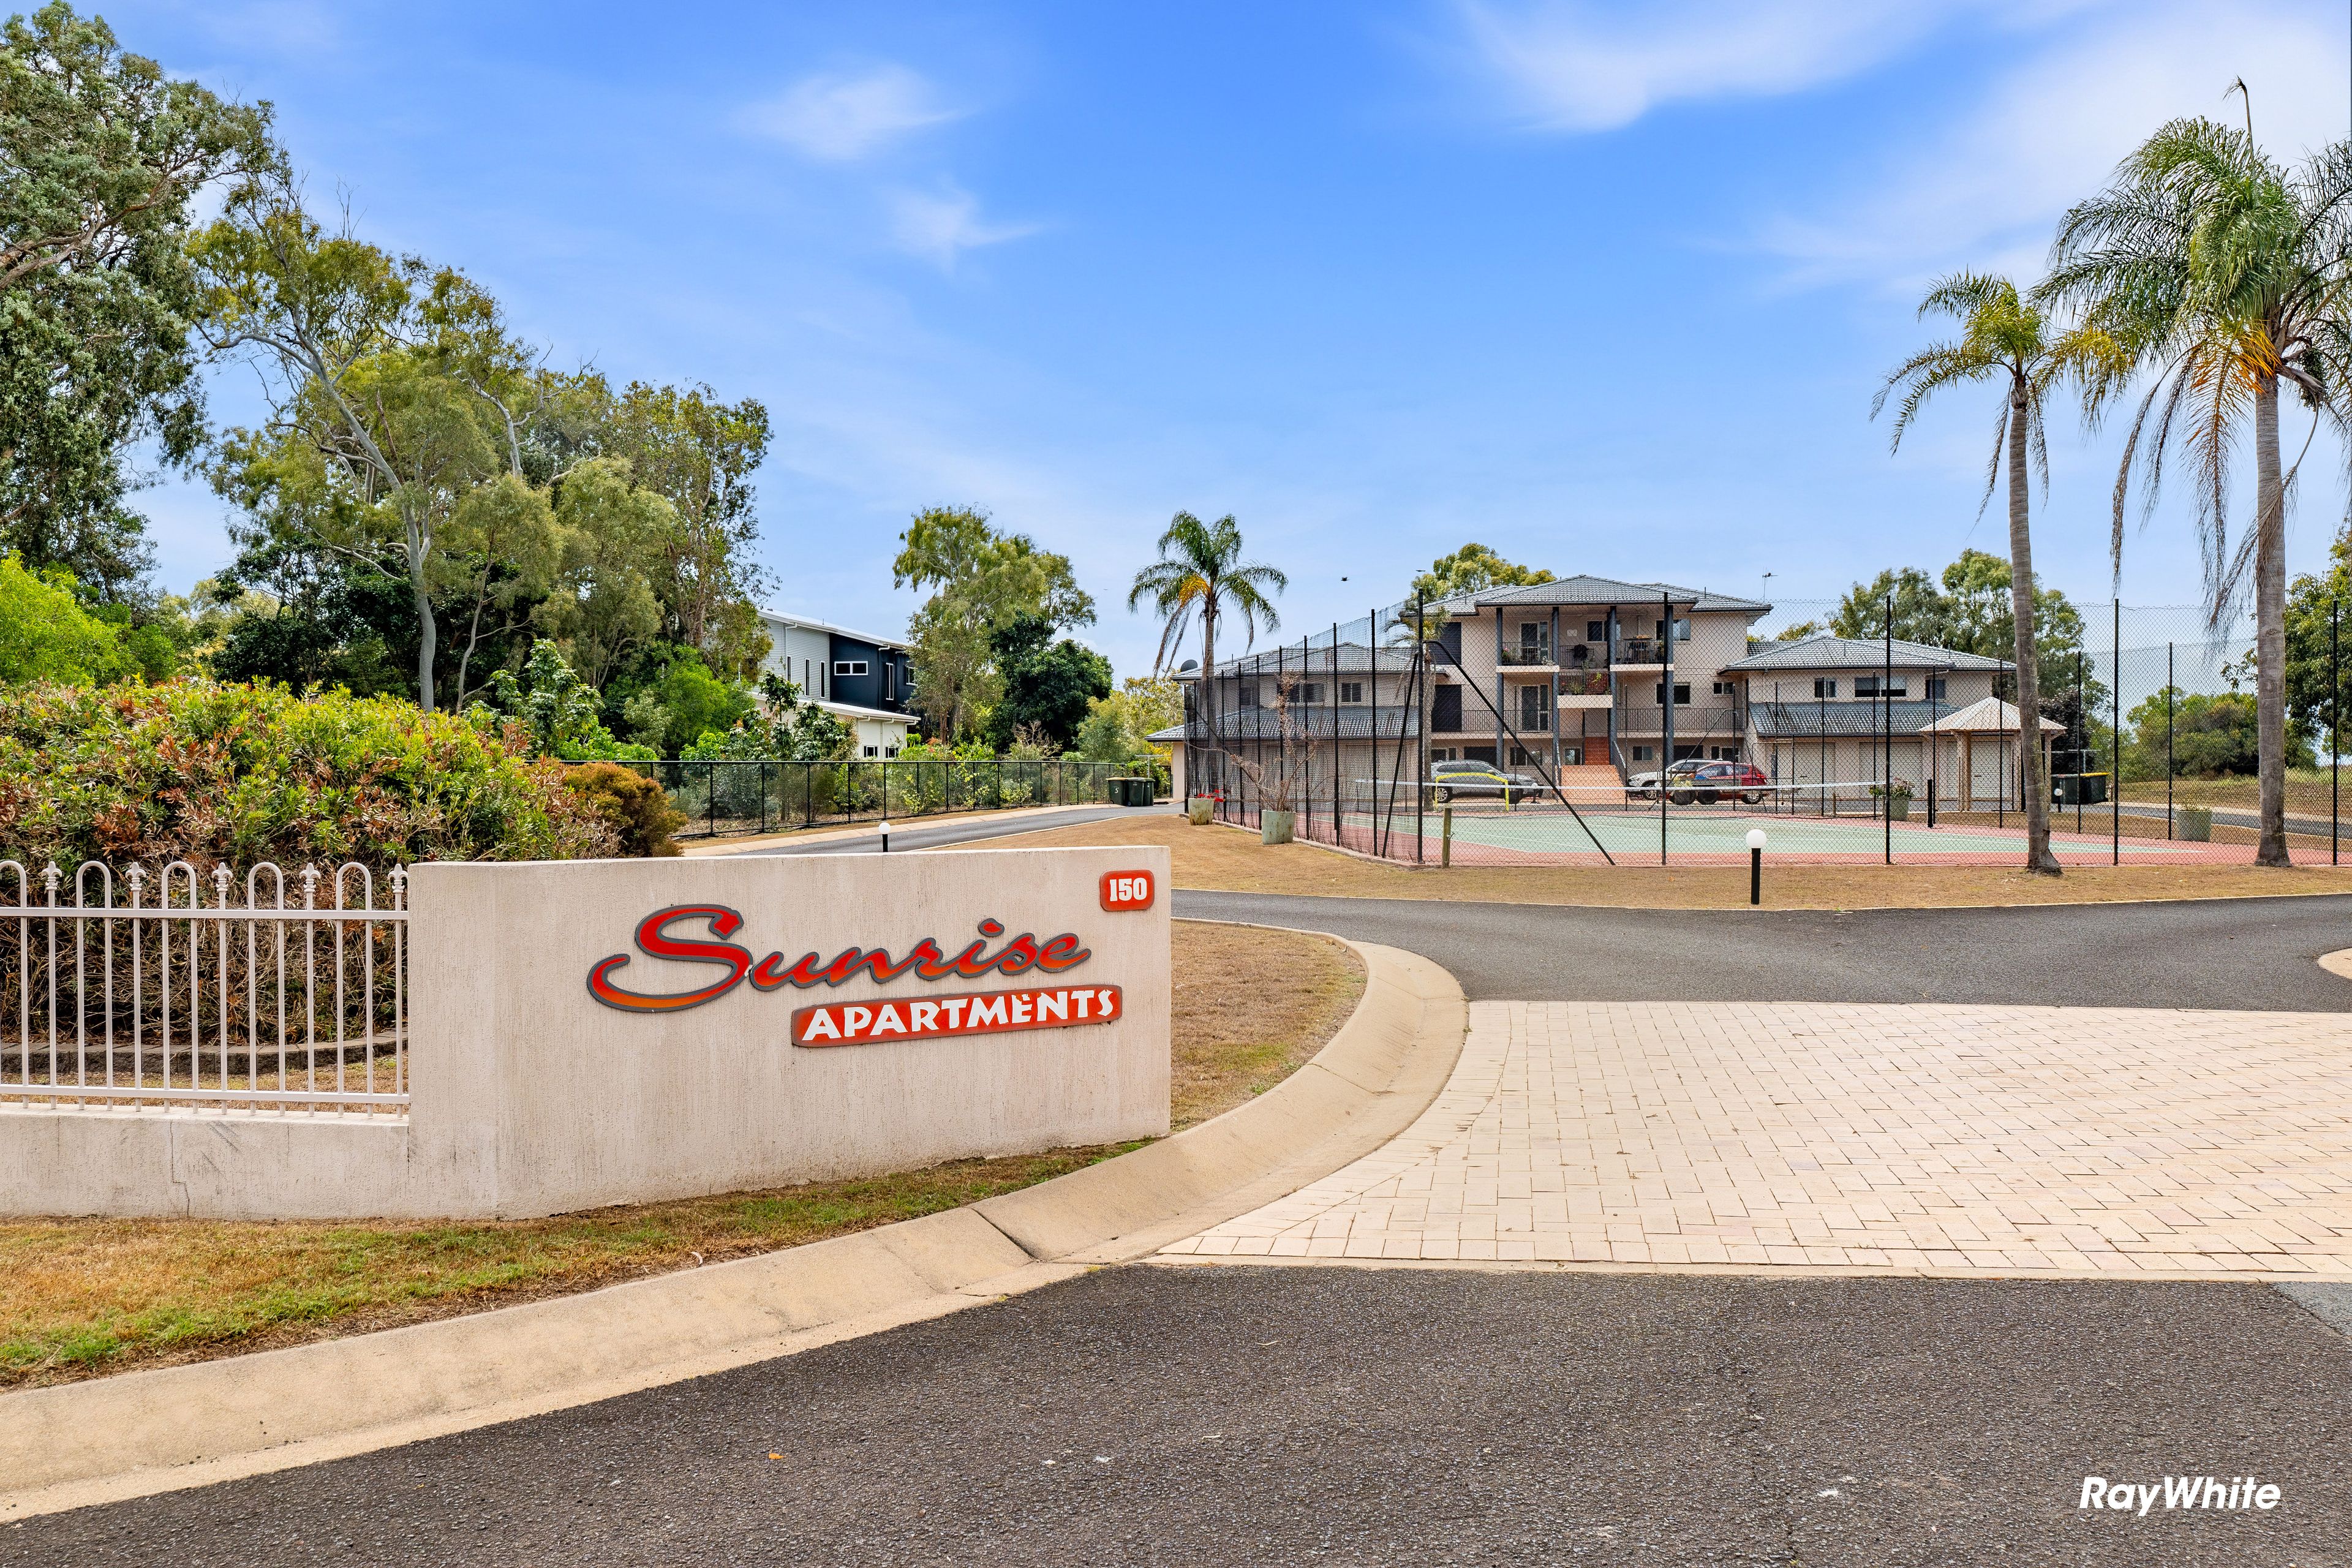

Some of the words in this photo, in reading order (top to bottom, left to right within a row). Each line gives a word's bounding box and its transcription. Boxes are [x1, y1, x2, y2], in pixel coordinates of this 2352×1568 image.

[1109, 877, 1147, 902] 150
[587, 904, 1092, 1012] Sunrise
[801, 989, 1114, 1041] APARTMENTS
